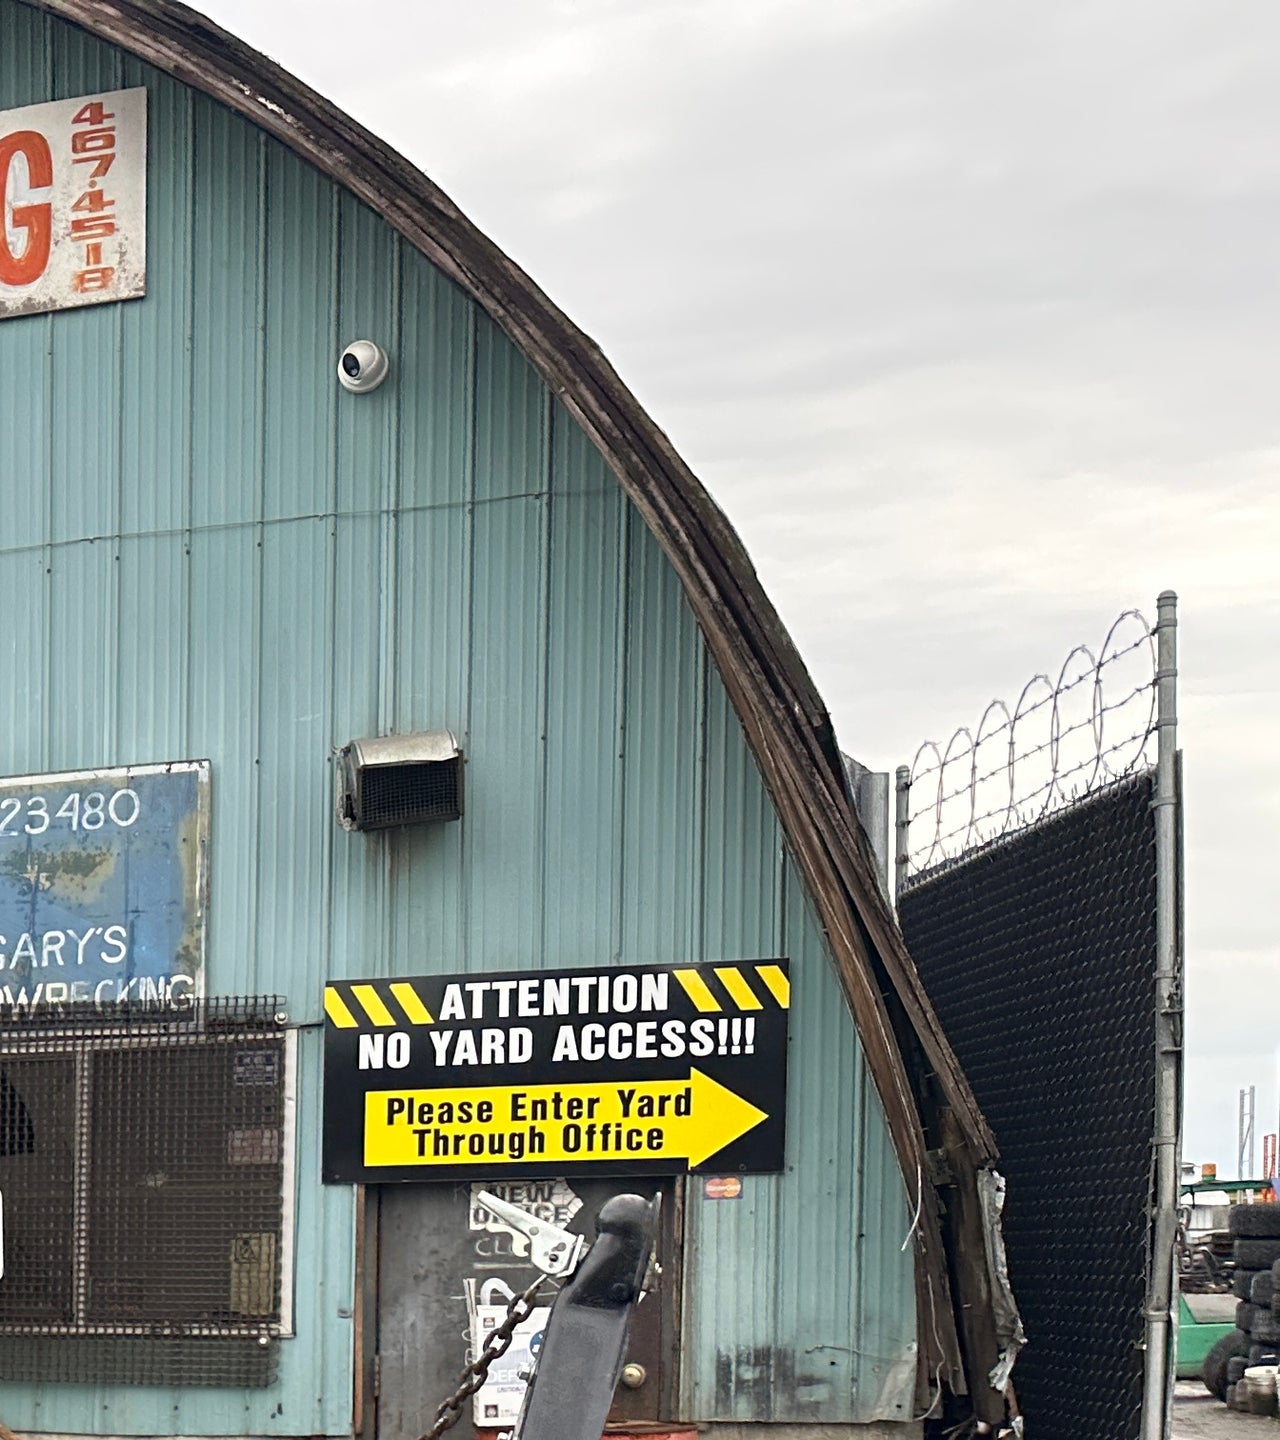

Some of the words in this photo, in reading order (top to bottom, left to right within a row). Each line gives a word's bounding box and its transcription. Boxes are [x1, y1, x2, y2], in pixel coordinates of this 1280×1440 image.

[439, 973, 669, 1021] ATTENTION
[358, 1031, 411, 1071] NO
[429, 1026, 534, 1067] YARD
[551, 1017, 757, 1062] ACCESS!!!
[386, 1097, 493, 1126] Please
[511, 1093, 600, 1122] Enter
[617, 1087, 692, 1118] Yard
[412, 1125, 545, 1160] Through
[562, 1122, 664, 1152] Office
